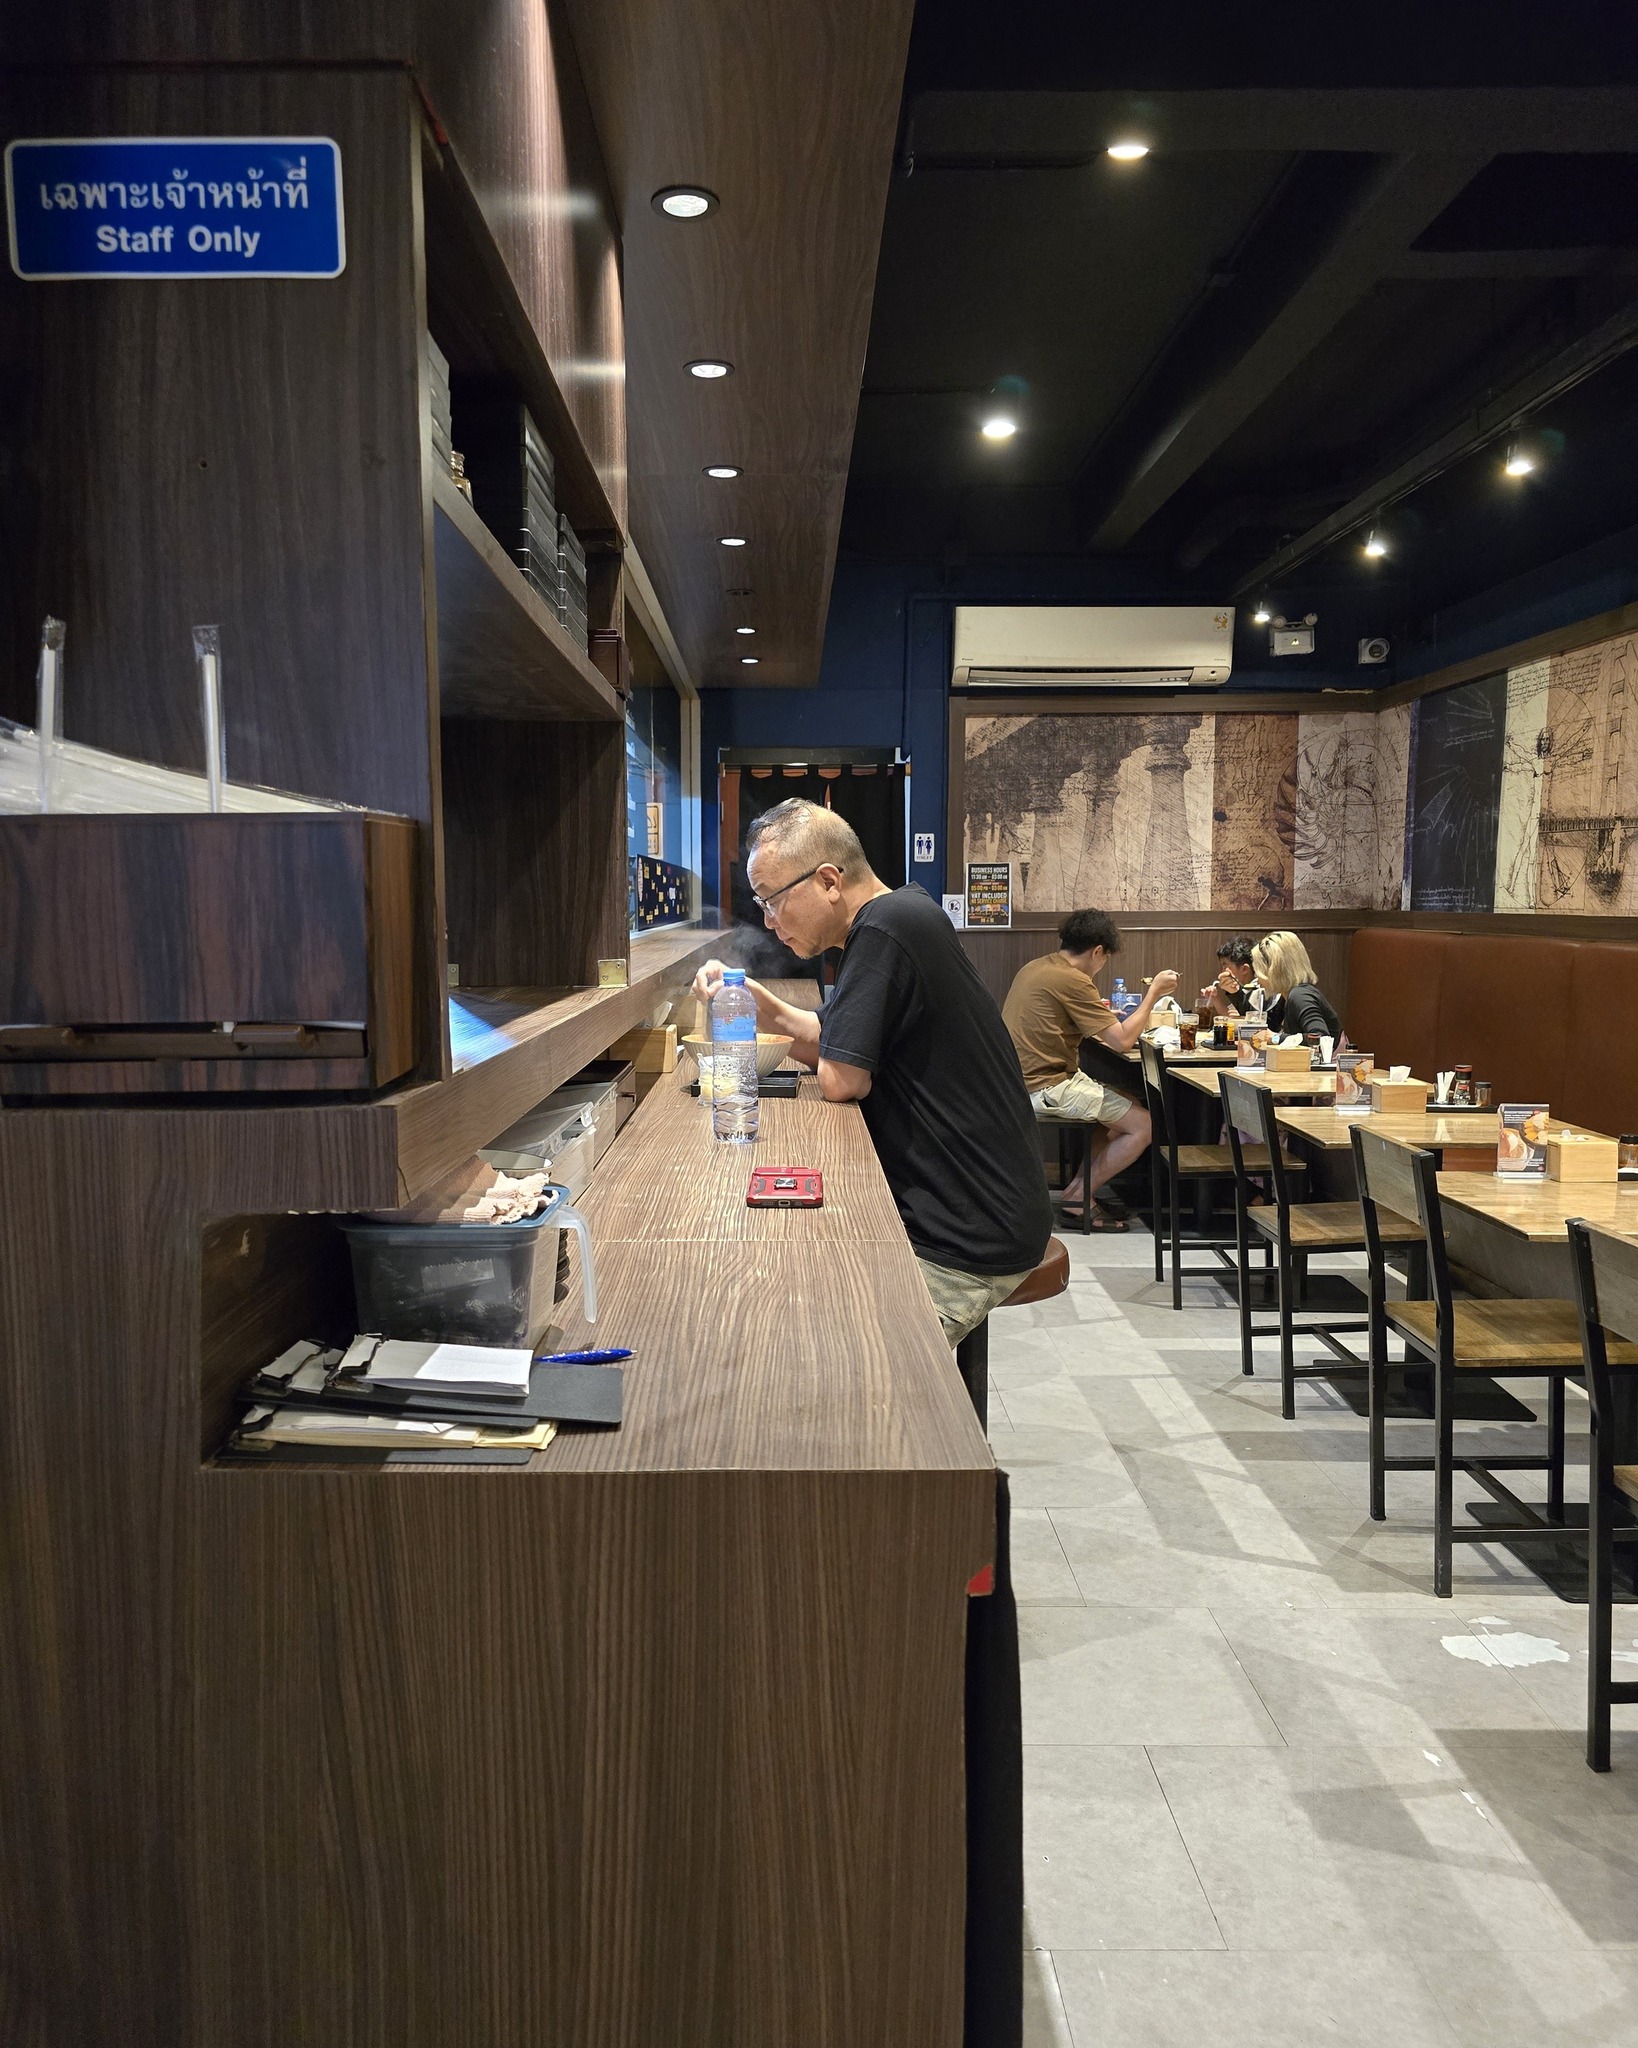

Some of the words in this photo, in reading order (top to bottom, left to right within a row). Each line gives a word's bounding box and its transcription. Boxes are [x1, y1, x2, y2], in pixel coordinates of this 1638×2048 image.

[40, 156, 309, 210] เฉพาะเจ้าหน้าที่
[96, 224, 174, 253] Staff
[188, 225, 261, 258] Only
